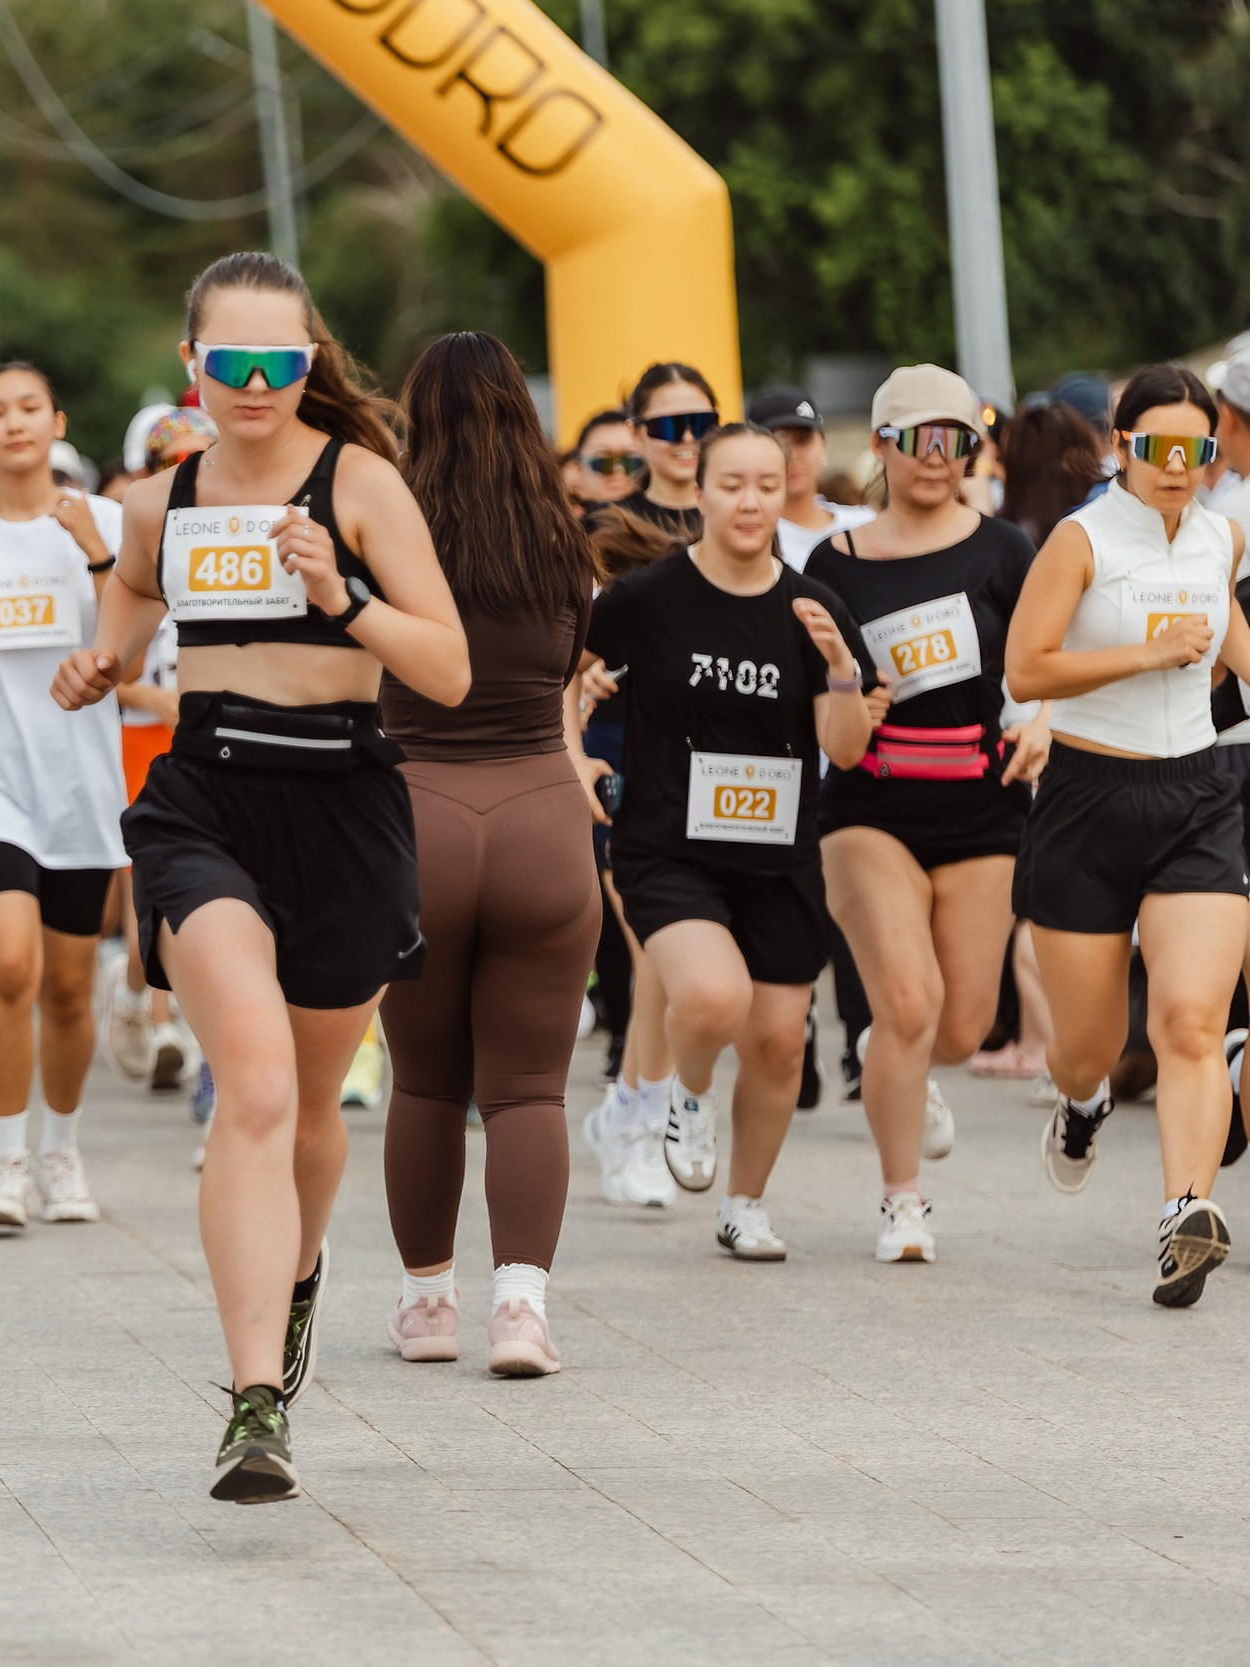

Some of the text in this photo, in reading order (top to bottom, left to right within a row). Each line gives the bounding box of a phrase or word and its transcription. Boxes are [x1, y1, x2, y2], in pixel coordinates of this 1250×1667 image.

[175, 521, 221, 536] LEONE
[195, 550, 264, 586] 486
[176, 595, 291, 607] БЛАГОТВОРИТЕЛЬНЫЙ ЗАБЕГ
[1132, 591, 1173, 605] LEONE
[896, 633, 951, 673] 278
[702, 763, 740, 779] LEONE
[719, 787, 771, 819] 022
